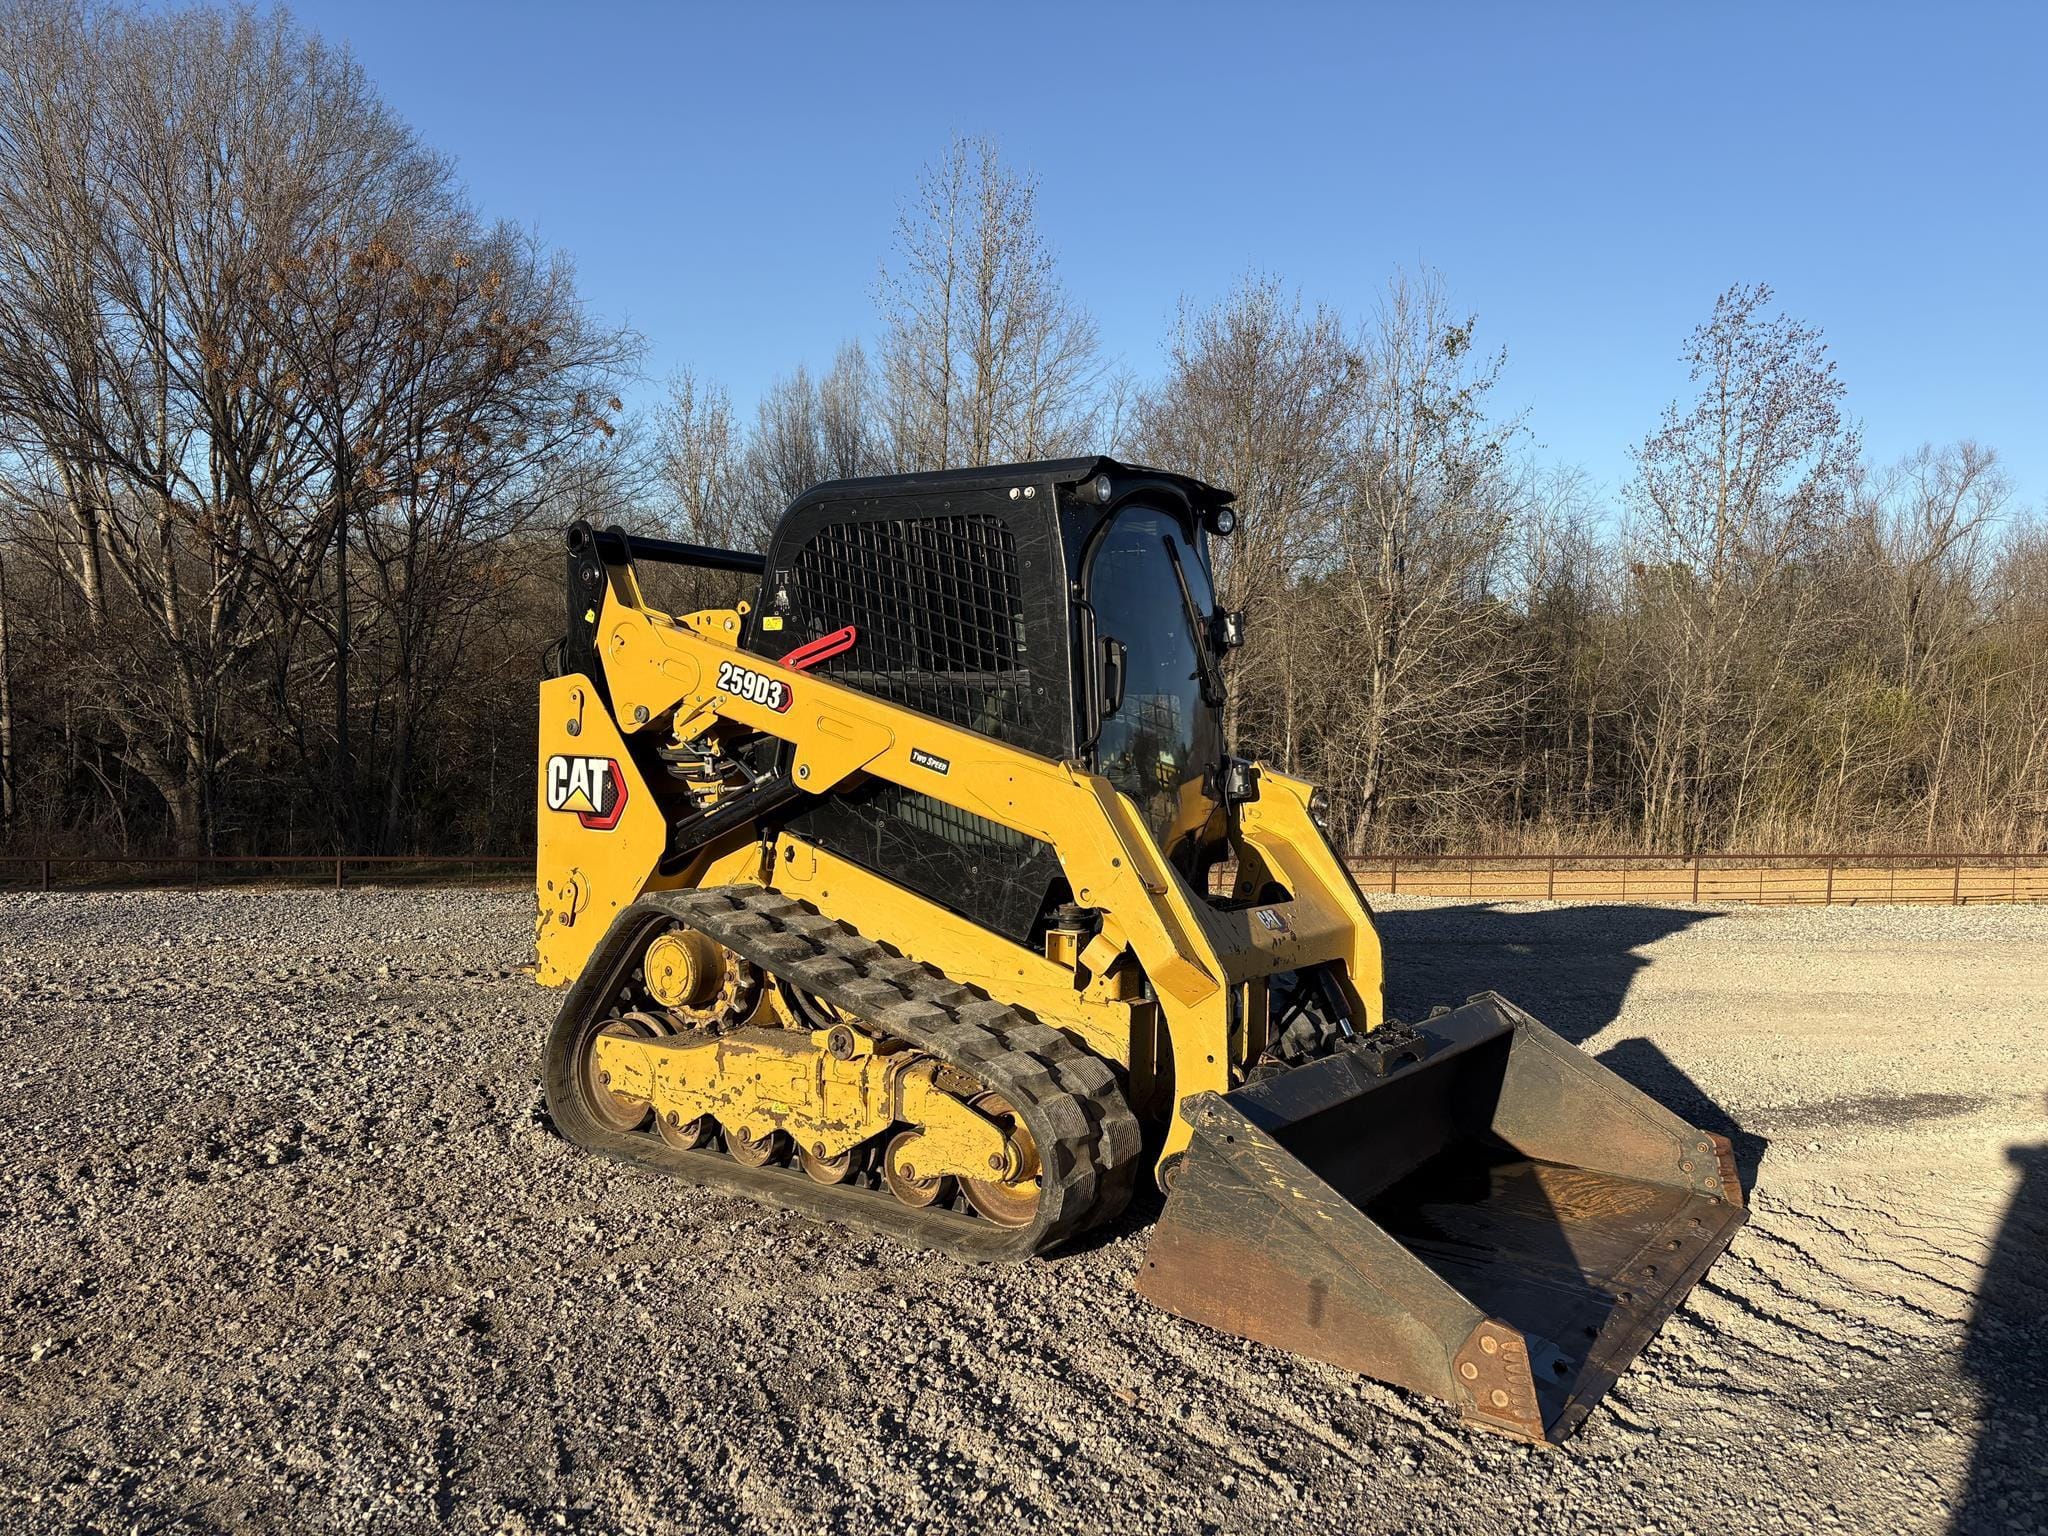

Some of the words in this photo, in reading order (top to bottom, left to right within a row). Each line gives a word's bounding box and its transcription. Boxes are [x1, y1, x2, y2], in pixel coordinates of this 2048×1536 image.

[717, 661, 782, 709] 259D3
[548, 756, 609, 812] CAT
[1256, 909, 1282, 930] CAT
